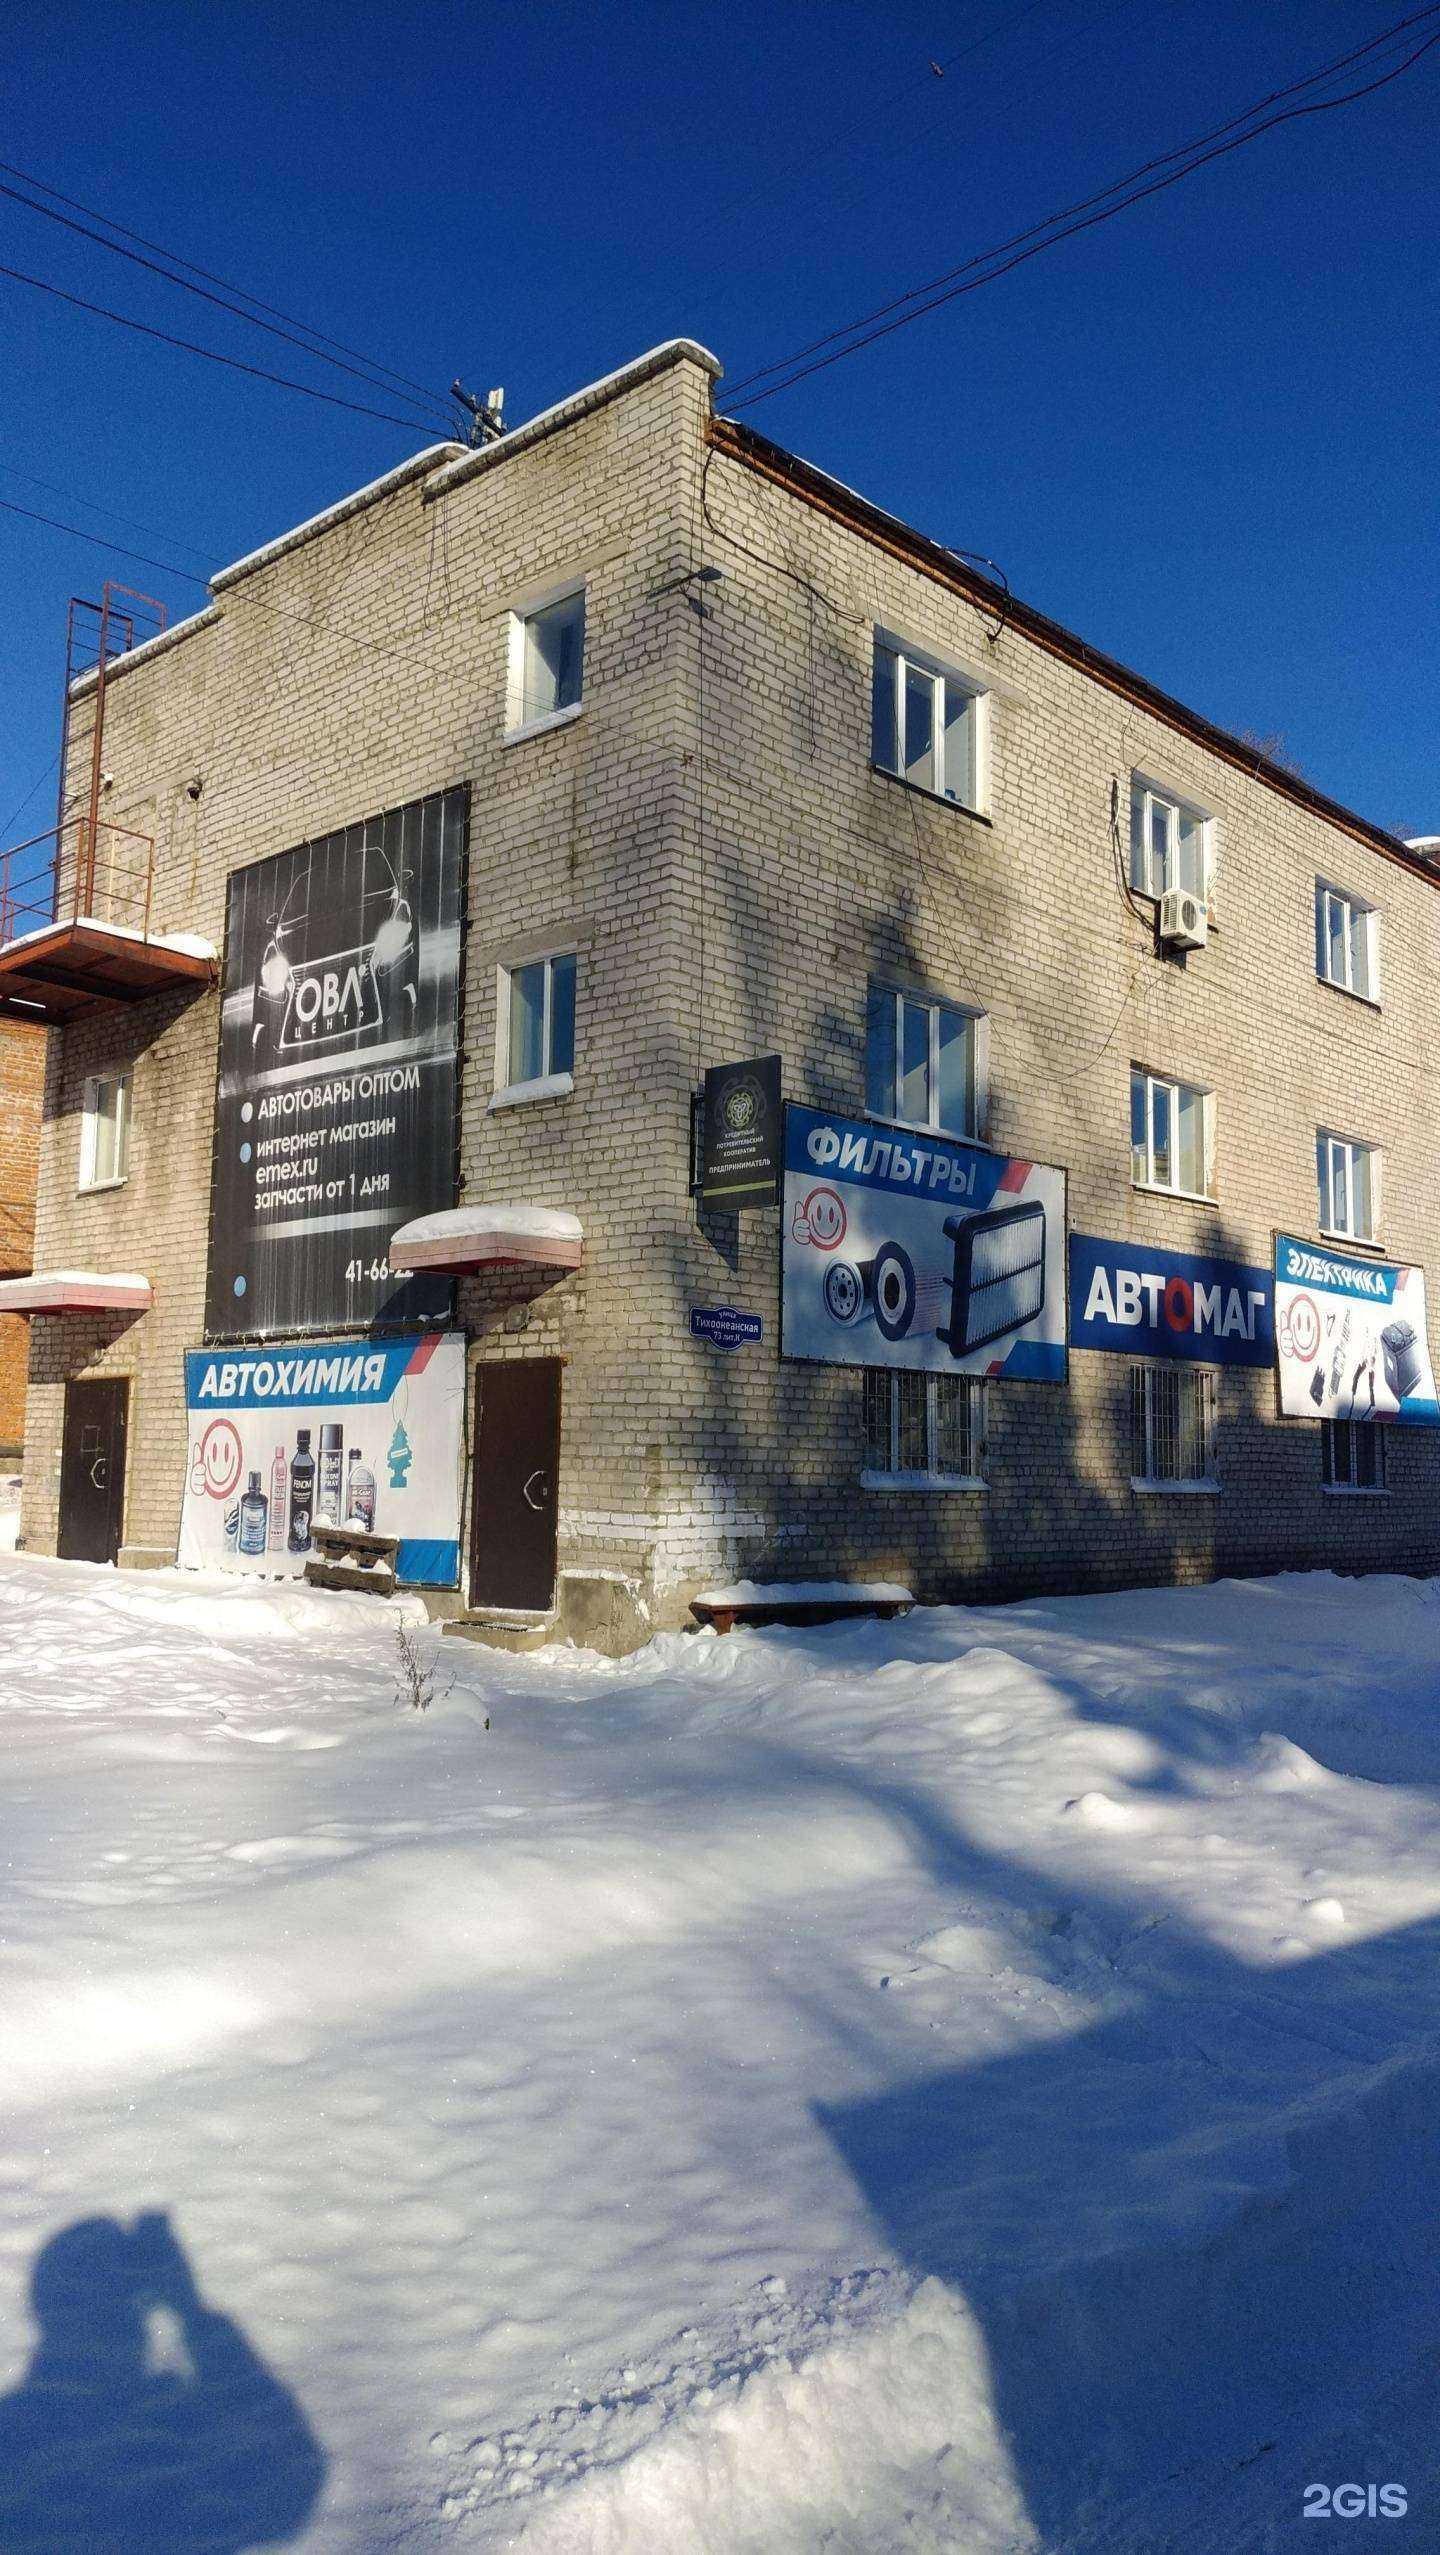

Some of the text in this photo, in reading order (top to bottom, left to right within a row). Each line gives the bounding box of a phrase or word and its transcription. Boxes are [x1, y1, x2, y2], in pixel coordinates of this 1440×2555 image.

[294, 1011, 364, 1039] ЦЕНТР
[258, 1066, 420, 1121] АВТОТОВАРЫ ОПТОМ
[257, 1117, 396, 1158] интернет магазин
[256, 1156, 318, 1184] emex.ru
[708, 1158, 771, 1174] ПРЕДПРИНИМАТЕЛЬ
[807, 1126, 976, 1195] ФИЛЬТРЫ
[254, 1173, 390, 1210] запчасти от 1 дня
[1286, 1248, 1388, 1297] ЭЛЕКТРИКА
[1083, 1265, 1266, 1340] АВТОМАГ
[695, 1316, 759, 1333] Тихоокеанская
[713, 1331, 722, 1340] 73
[199, 1354, 386, 1398] АВТОХИМИЯ
